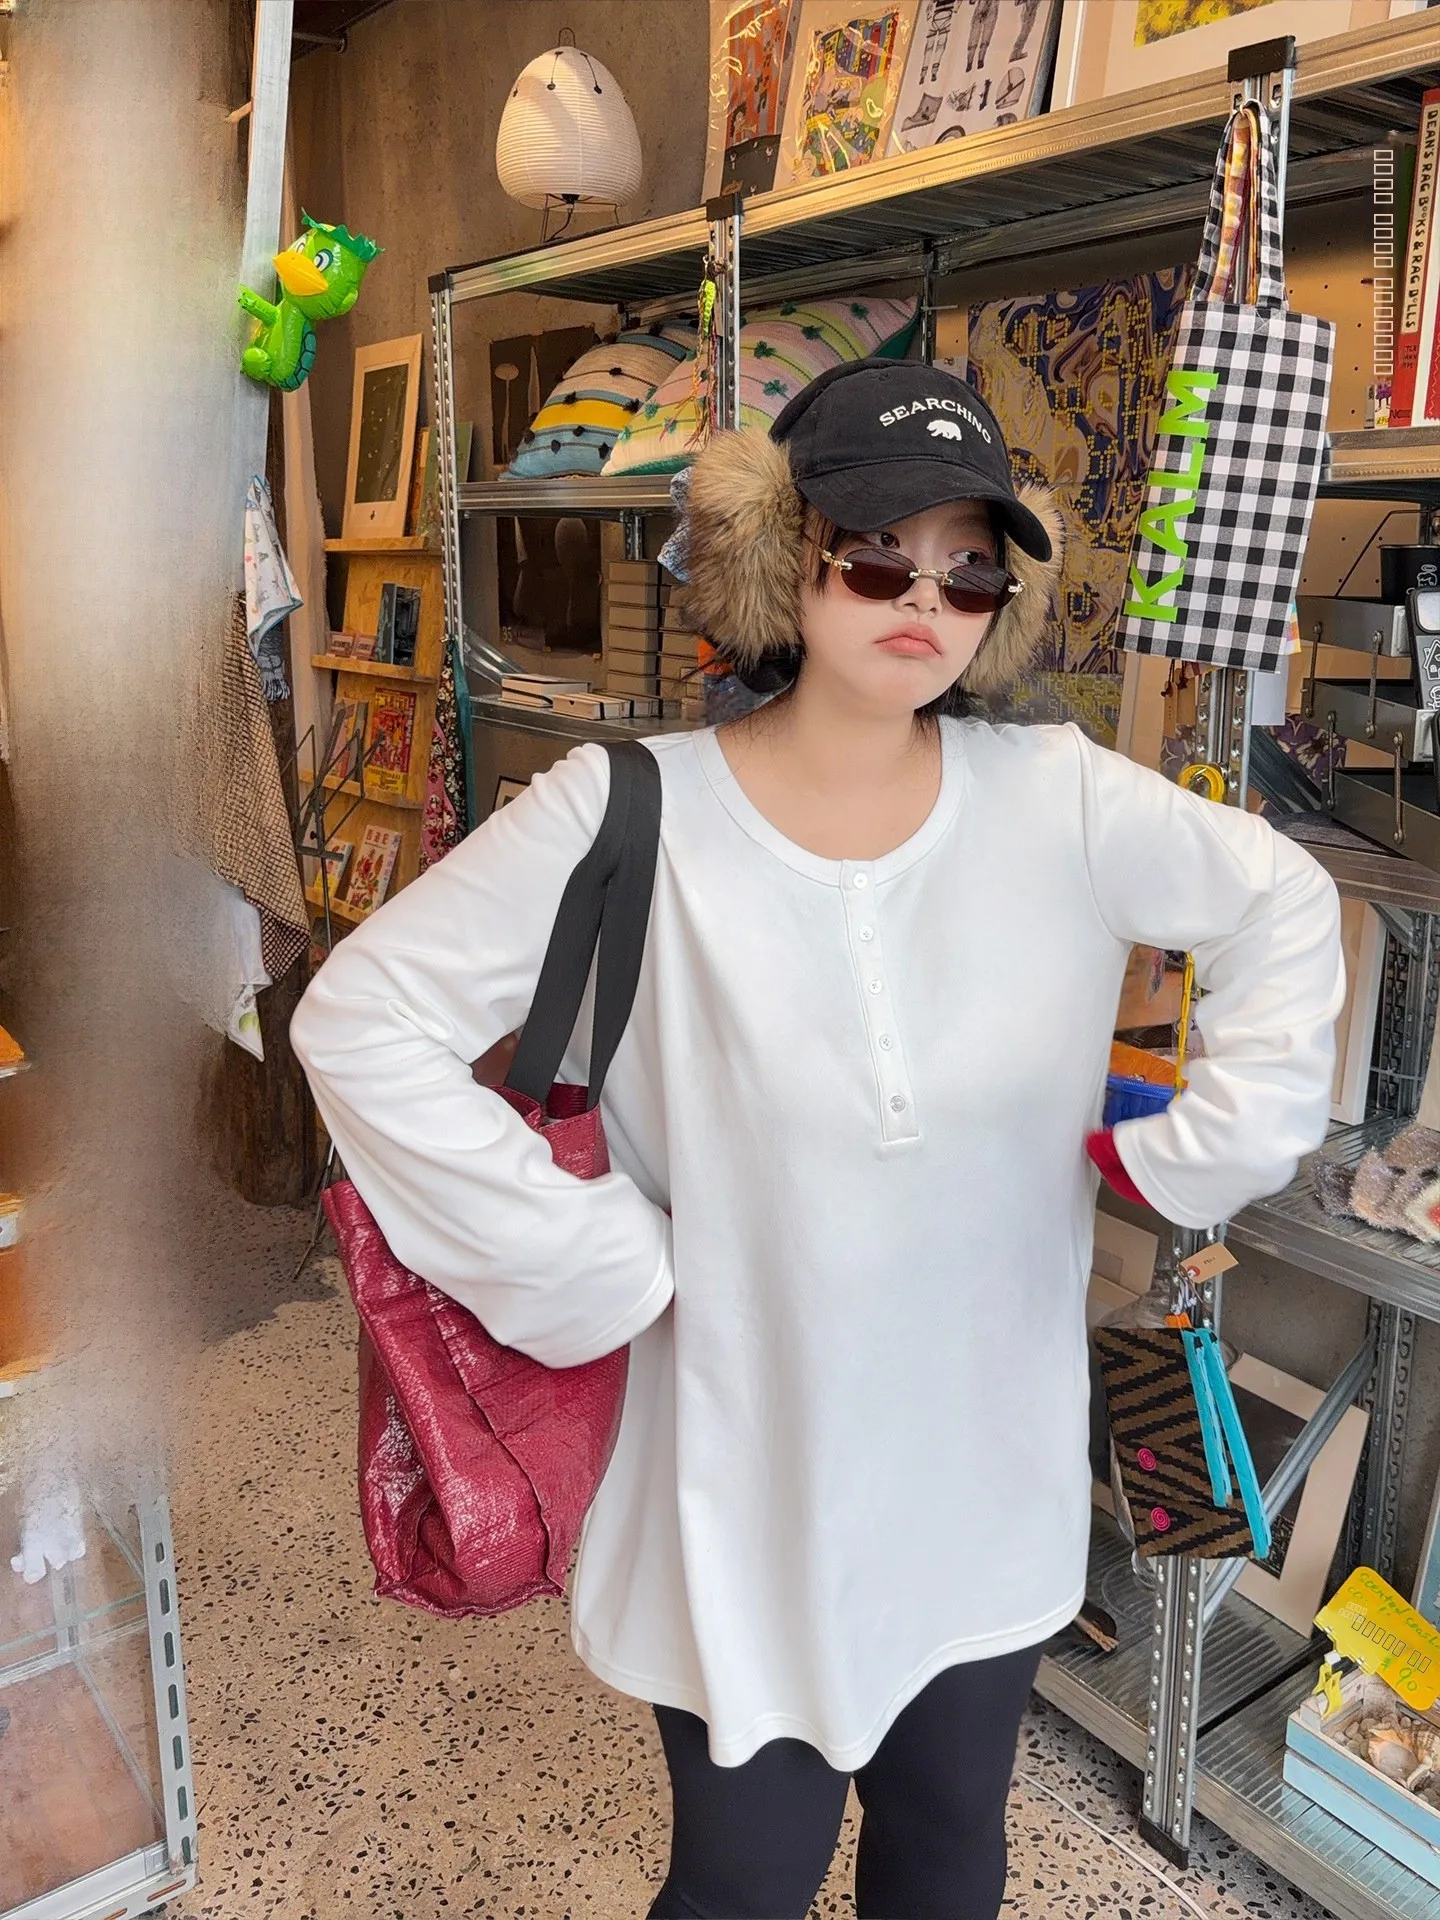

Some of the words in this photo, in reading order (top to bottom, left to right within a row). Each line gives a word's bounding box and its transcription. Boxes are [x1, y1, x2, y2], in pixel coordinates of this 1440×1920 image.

[1423, 109, 1439, 160] DEAN'S
[1420, 163, 1433, 193] RAG
[1413, 241, 1424, 251] &
[1410, 255, 1423, 284] RAG
[879, 397, 991, 444] SEARCHING
[1123, 371, 1219, 623] KALM
